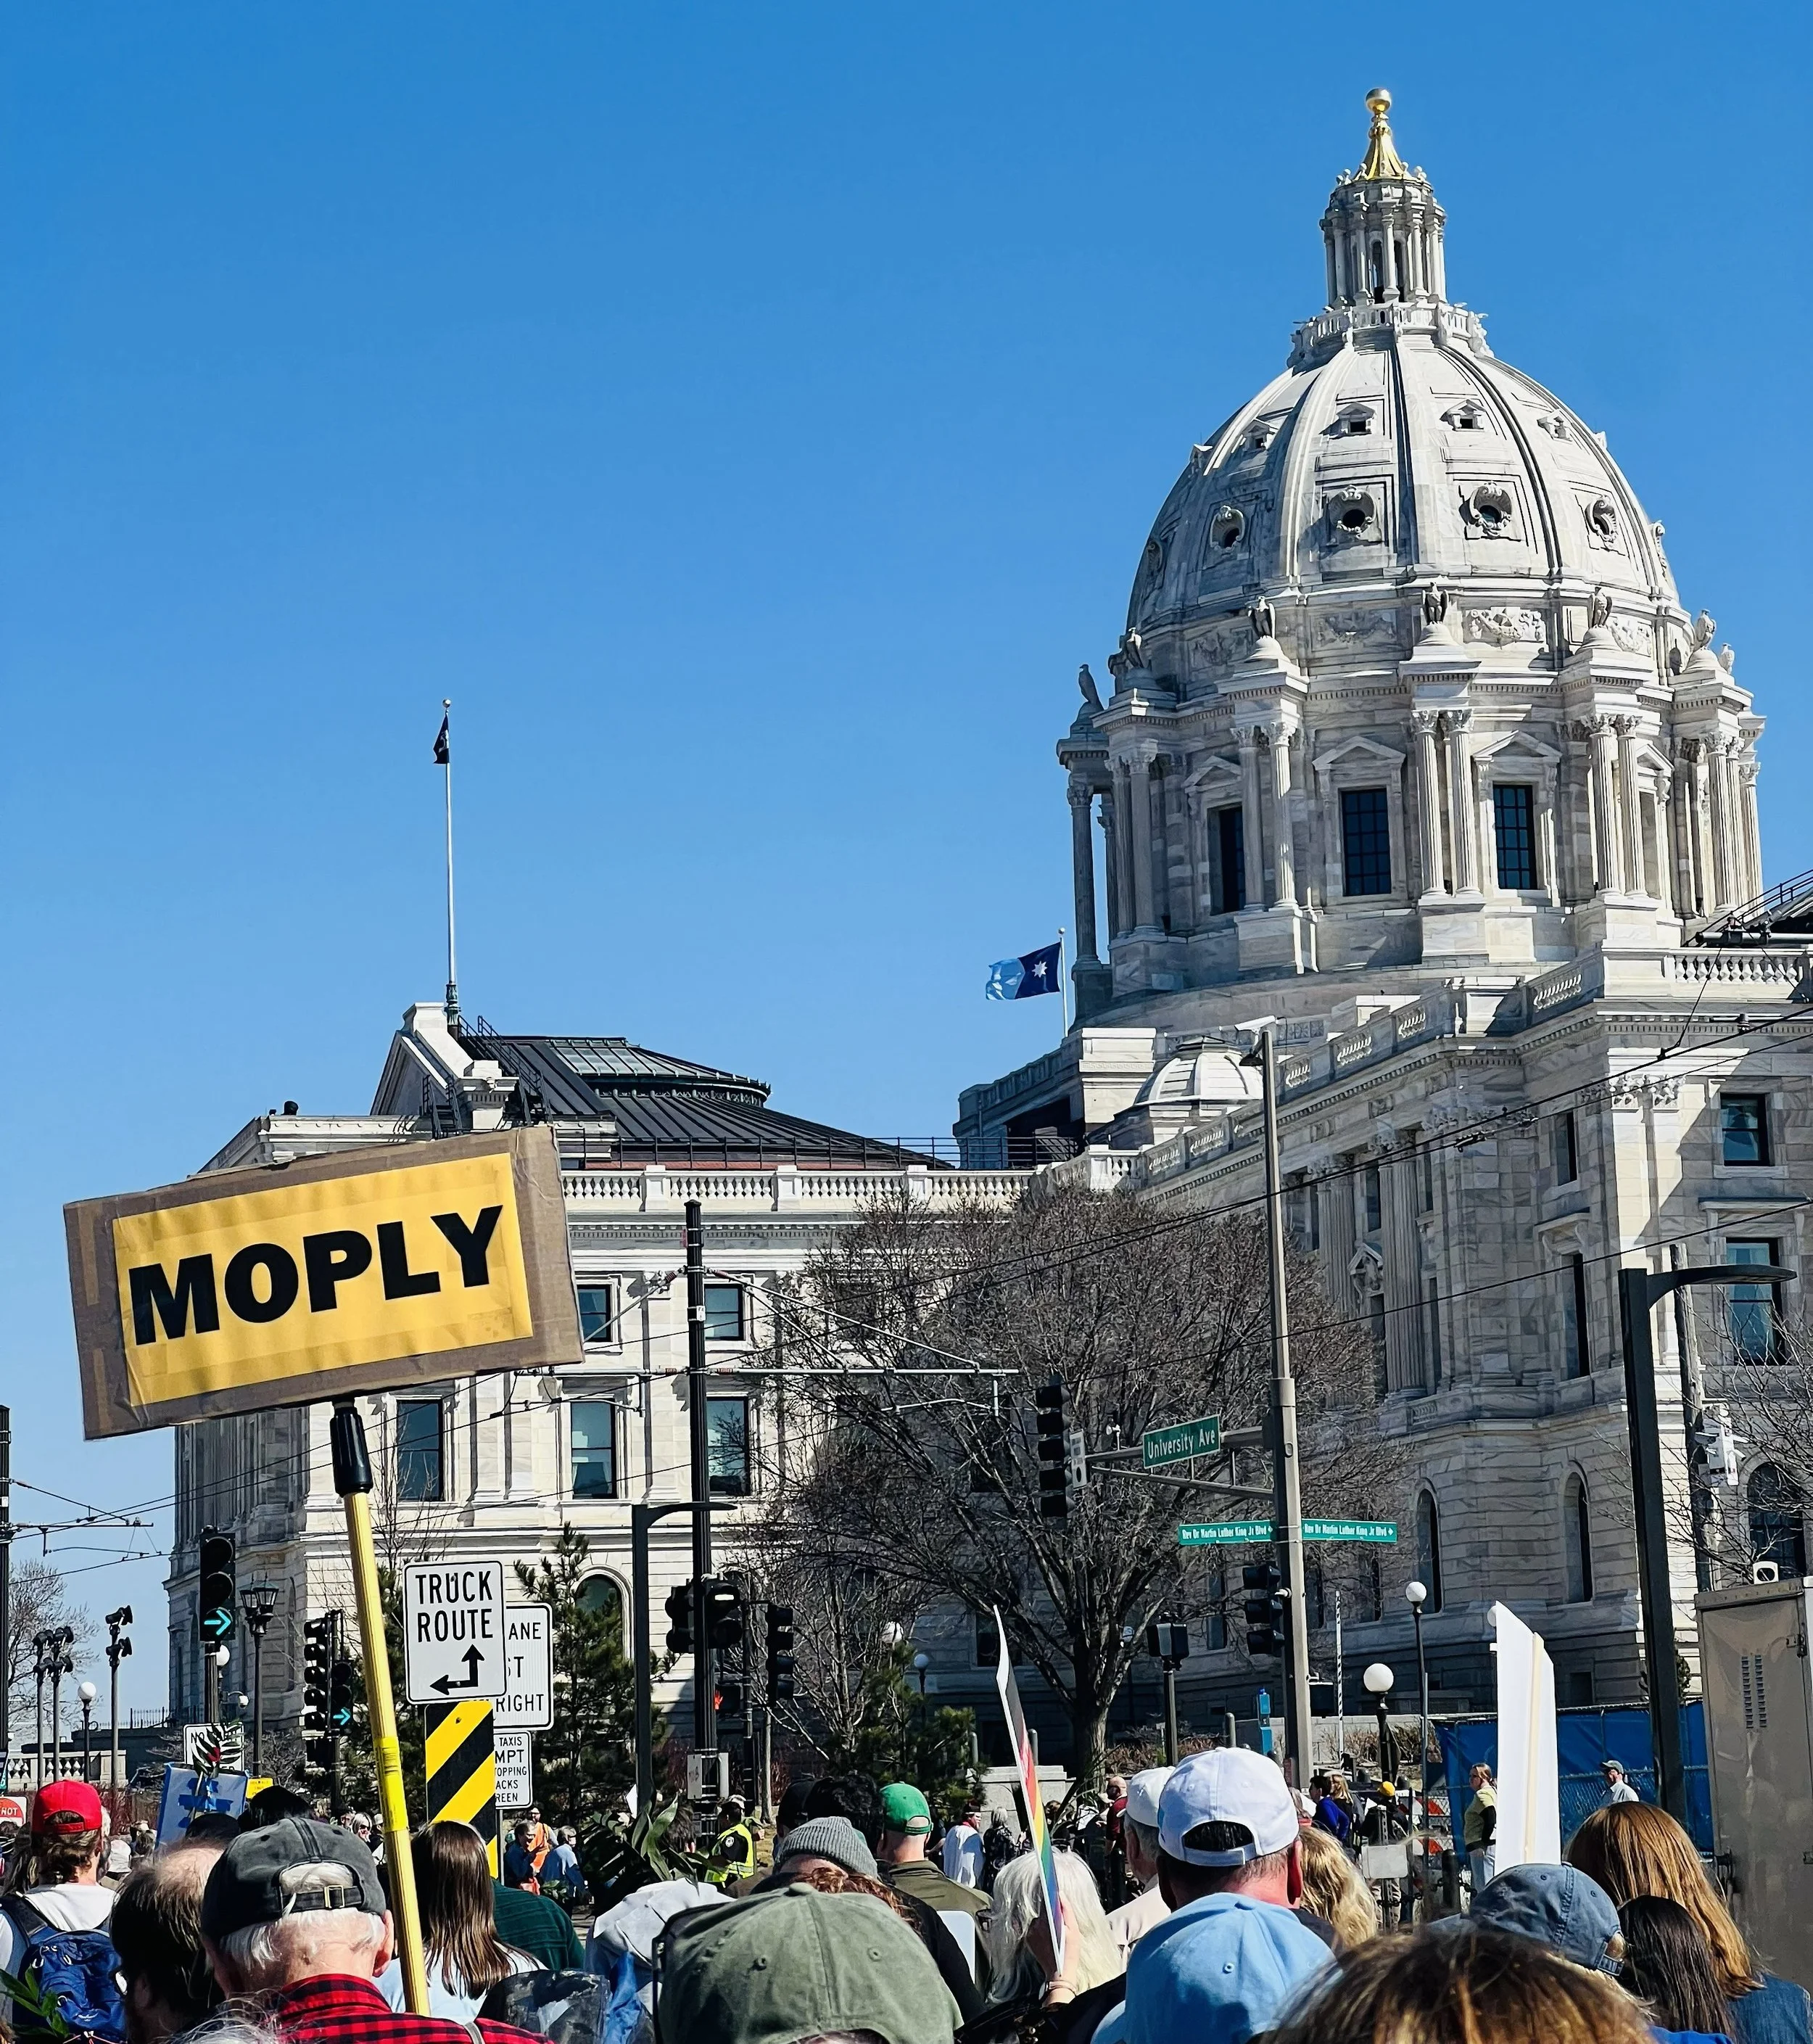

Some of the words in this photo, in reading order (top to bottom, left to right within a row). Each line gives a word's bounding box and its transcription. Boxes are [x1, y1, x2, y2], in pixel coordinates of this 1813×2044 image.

[128, 1204, 503, 1346] MOPLY
[1148, 1433, 1194, 1459] University
[1199, 1428, 1215, 1448] Ave
[415, 1570, 493, 1605] TRUCK
[417, 1608, 494, 1643] ROUTE
[508, 1622, 542, 1640] ANE
[496, 1694, 545, 1713] RIGHT
[499, 1736, 522, 1747] TAXIS
[495, 1749, 525, 1764] MPT
[495, 1765, 527, 1777] OPPING
[495, 1779, 519, 1790] ACKS
[495, 1792, 518, 1802] REEN
[1, 1807, 18, 1816] NOT
